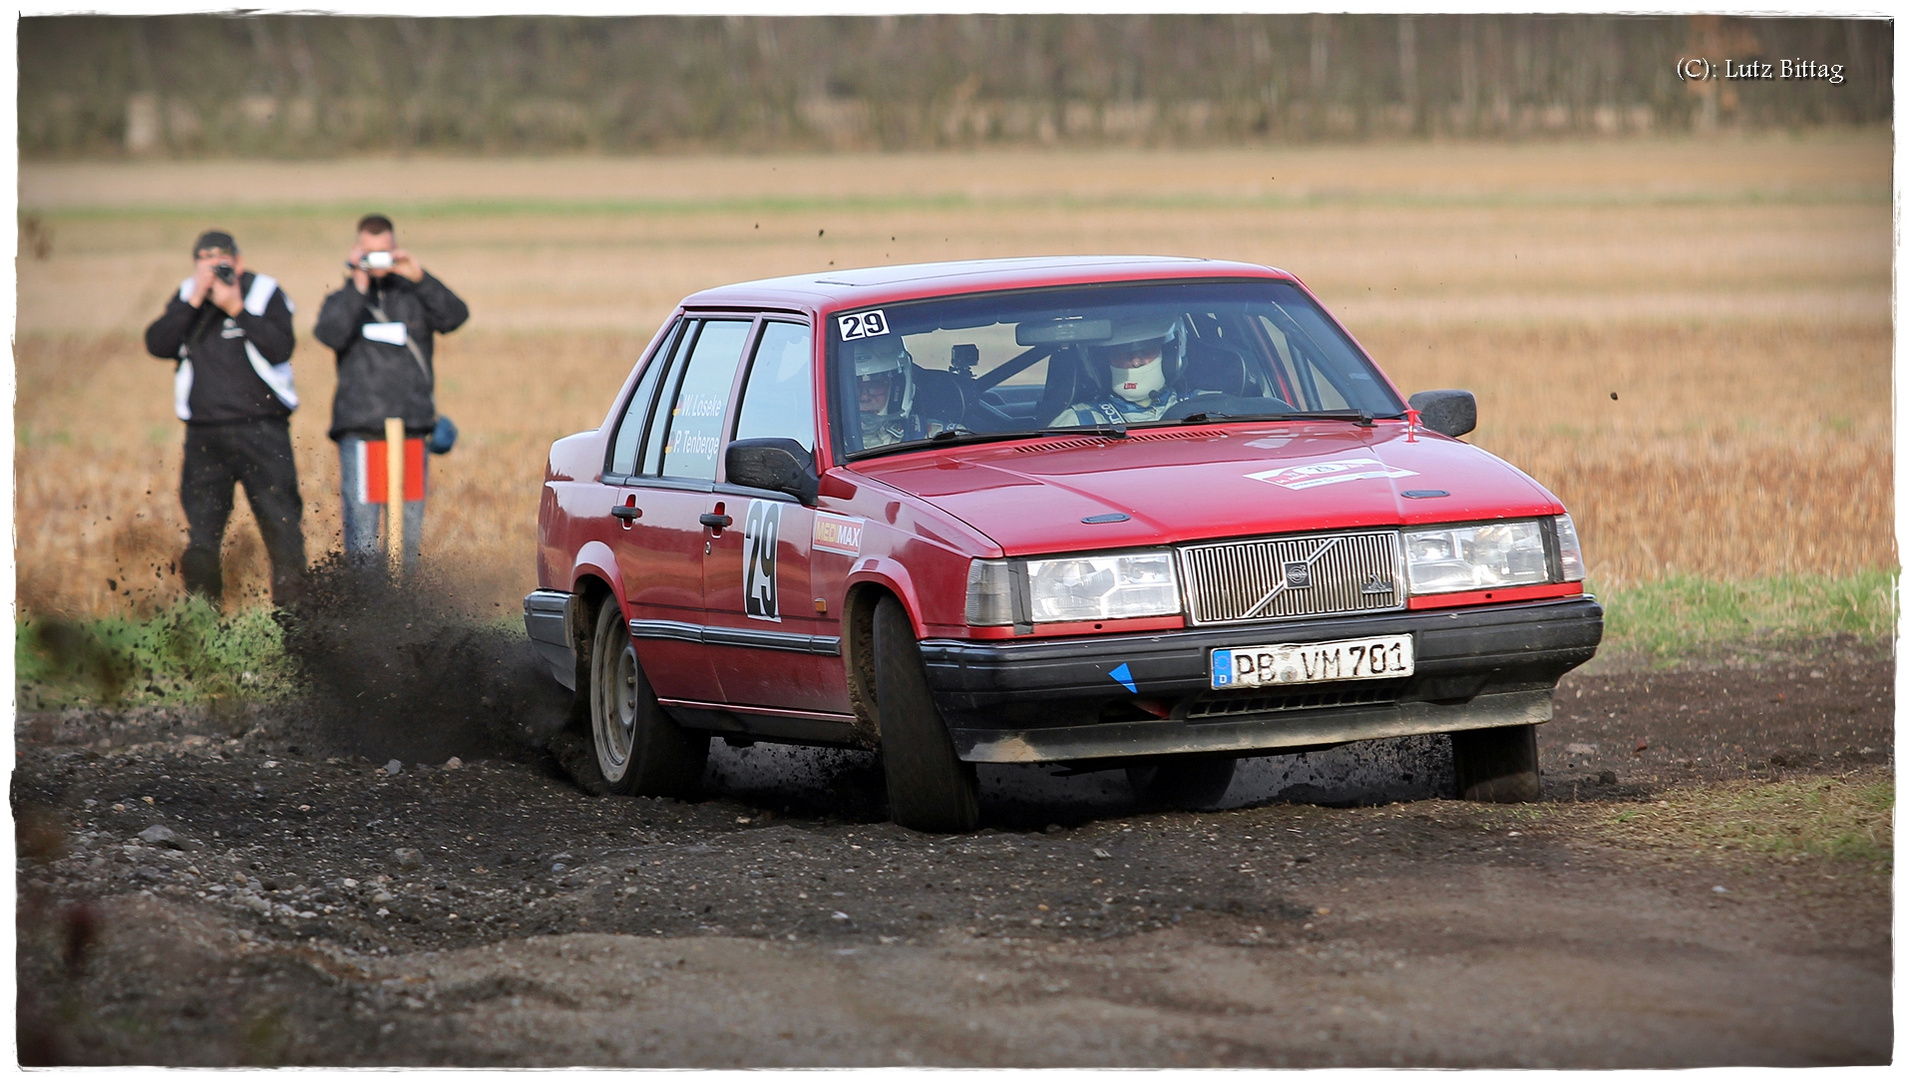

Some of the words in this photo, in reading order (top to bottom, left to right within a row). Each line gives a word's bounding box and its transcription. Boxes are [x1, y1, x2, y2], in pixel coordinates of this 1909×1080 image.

[842, 312, 885, 339] 29
[682, 430, 720, 461] Tenberge
[745, 500, 779, 618] 29
[1235, 653, 1276, 684] PB
[1301, 648, 1340, 679] VM
[1349, 642, 1406, 676] 701
[1219, 674, 1228, 684] D
